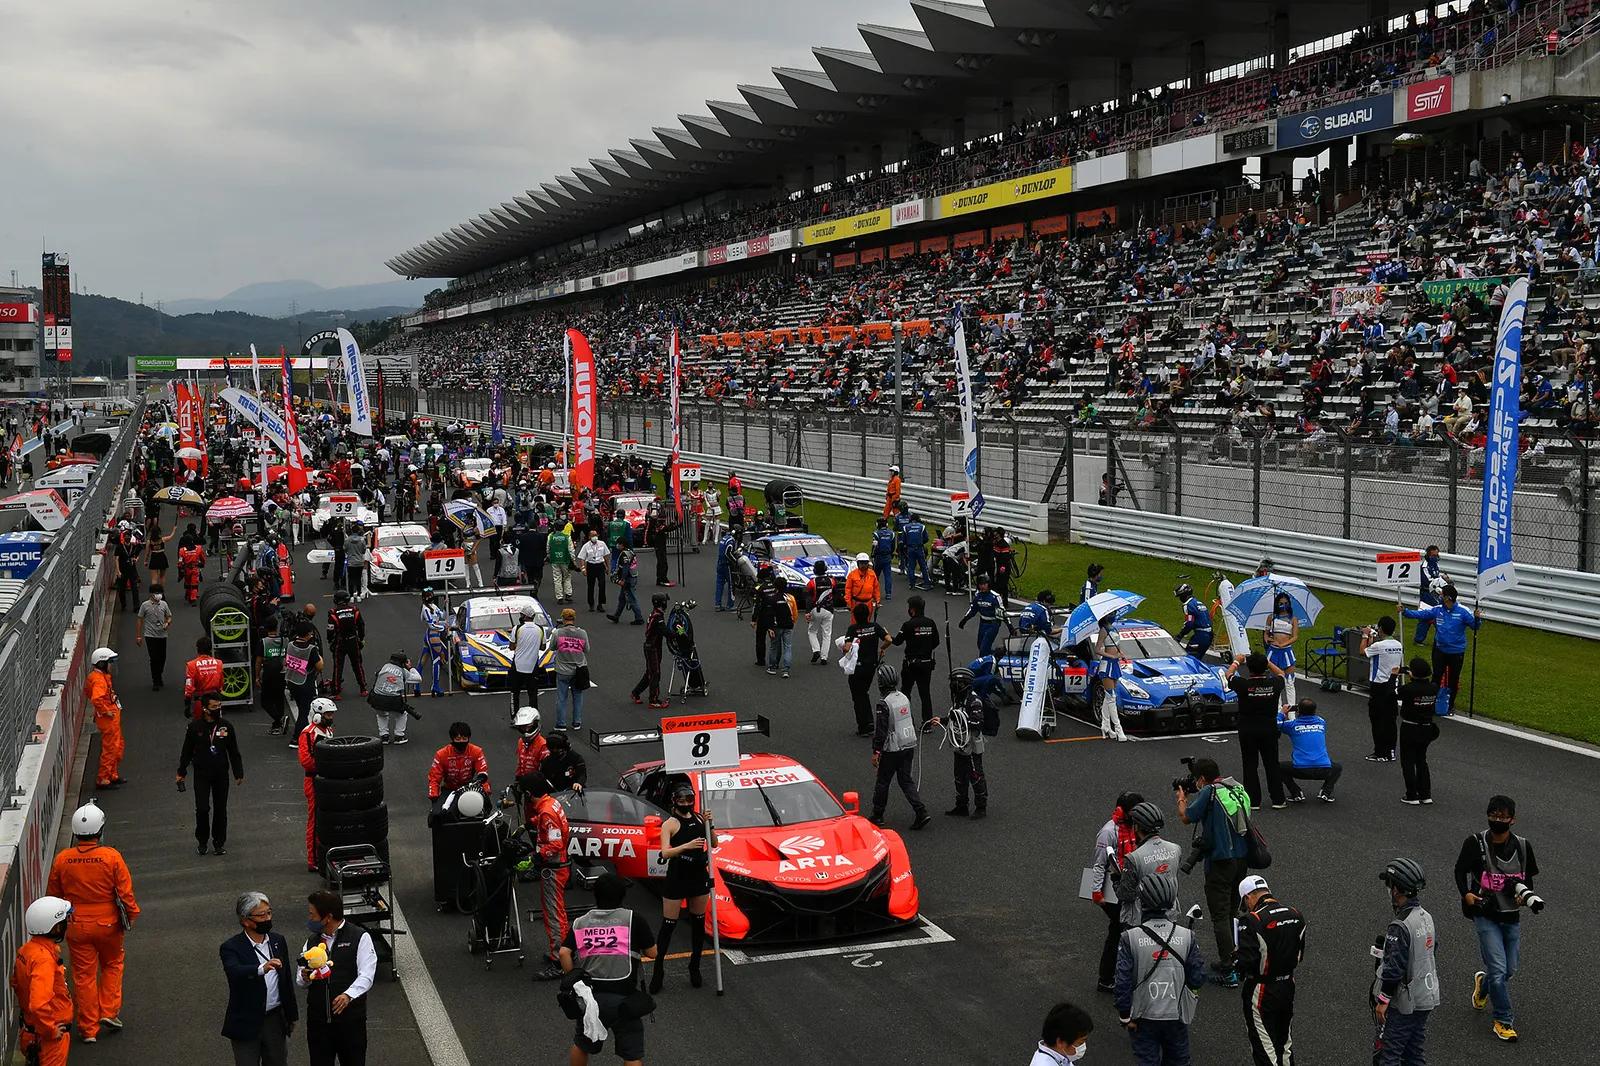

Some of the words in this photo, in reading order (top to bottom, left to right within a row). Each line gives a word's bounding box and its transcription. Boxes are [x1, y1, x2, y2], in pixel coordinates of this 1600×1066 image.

[1324, 108, 1373, 130] SUBARU
[1020, 178, 1056, 195] DUNLOP
[957, 193, 988, 208] DUNLOP
[900, 204, 920, 219] YAMAHA
[857, 216, 880, 229] DUNLOP
[815, 226, 836, 238] DUNLOP
[749, 240, 769, 255] NISSAN
[305, 331, 339, 350] POTEN
[683, 469, 697, 477] 23
[335, 502, 353, 512] 39
[0, 551, 41, 560] SONIC
[434, 558, 456, 573] 19
[1387, 563, 1411, 579] 12
[1121, 631, 1160, 639] BOSCH
[196, 659, 218, 667] ARTA
[1028, 643, 1040, 671] TEAM
[1069, 675, 1083, 686] 12
[1024, 674, 1036, 707] IMPUL
[677, 717, 734, 728] AUTOBACS
[690, 732, 711, 758] 8
[740, 772, 800, 788] BOSCH
[602, 827, 644, 835] HONDA
[567, 837, 637, 858] ARTA
[778, 855, 854, 873] ARTA
[1143, 851, 1178, 865] BROADCAST
[584, 928, 616, 936] MEDIA
[583, 936, 618, 949] 352
